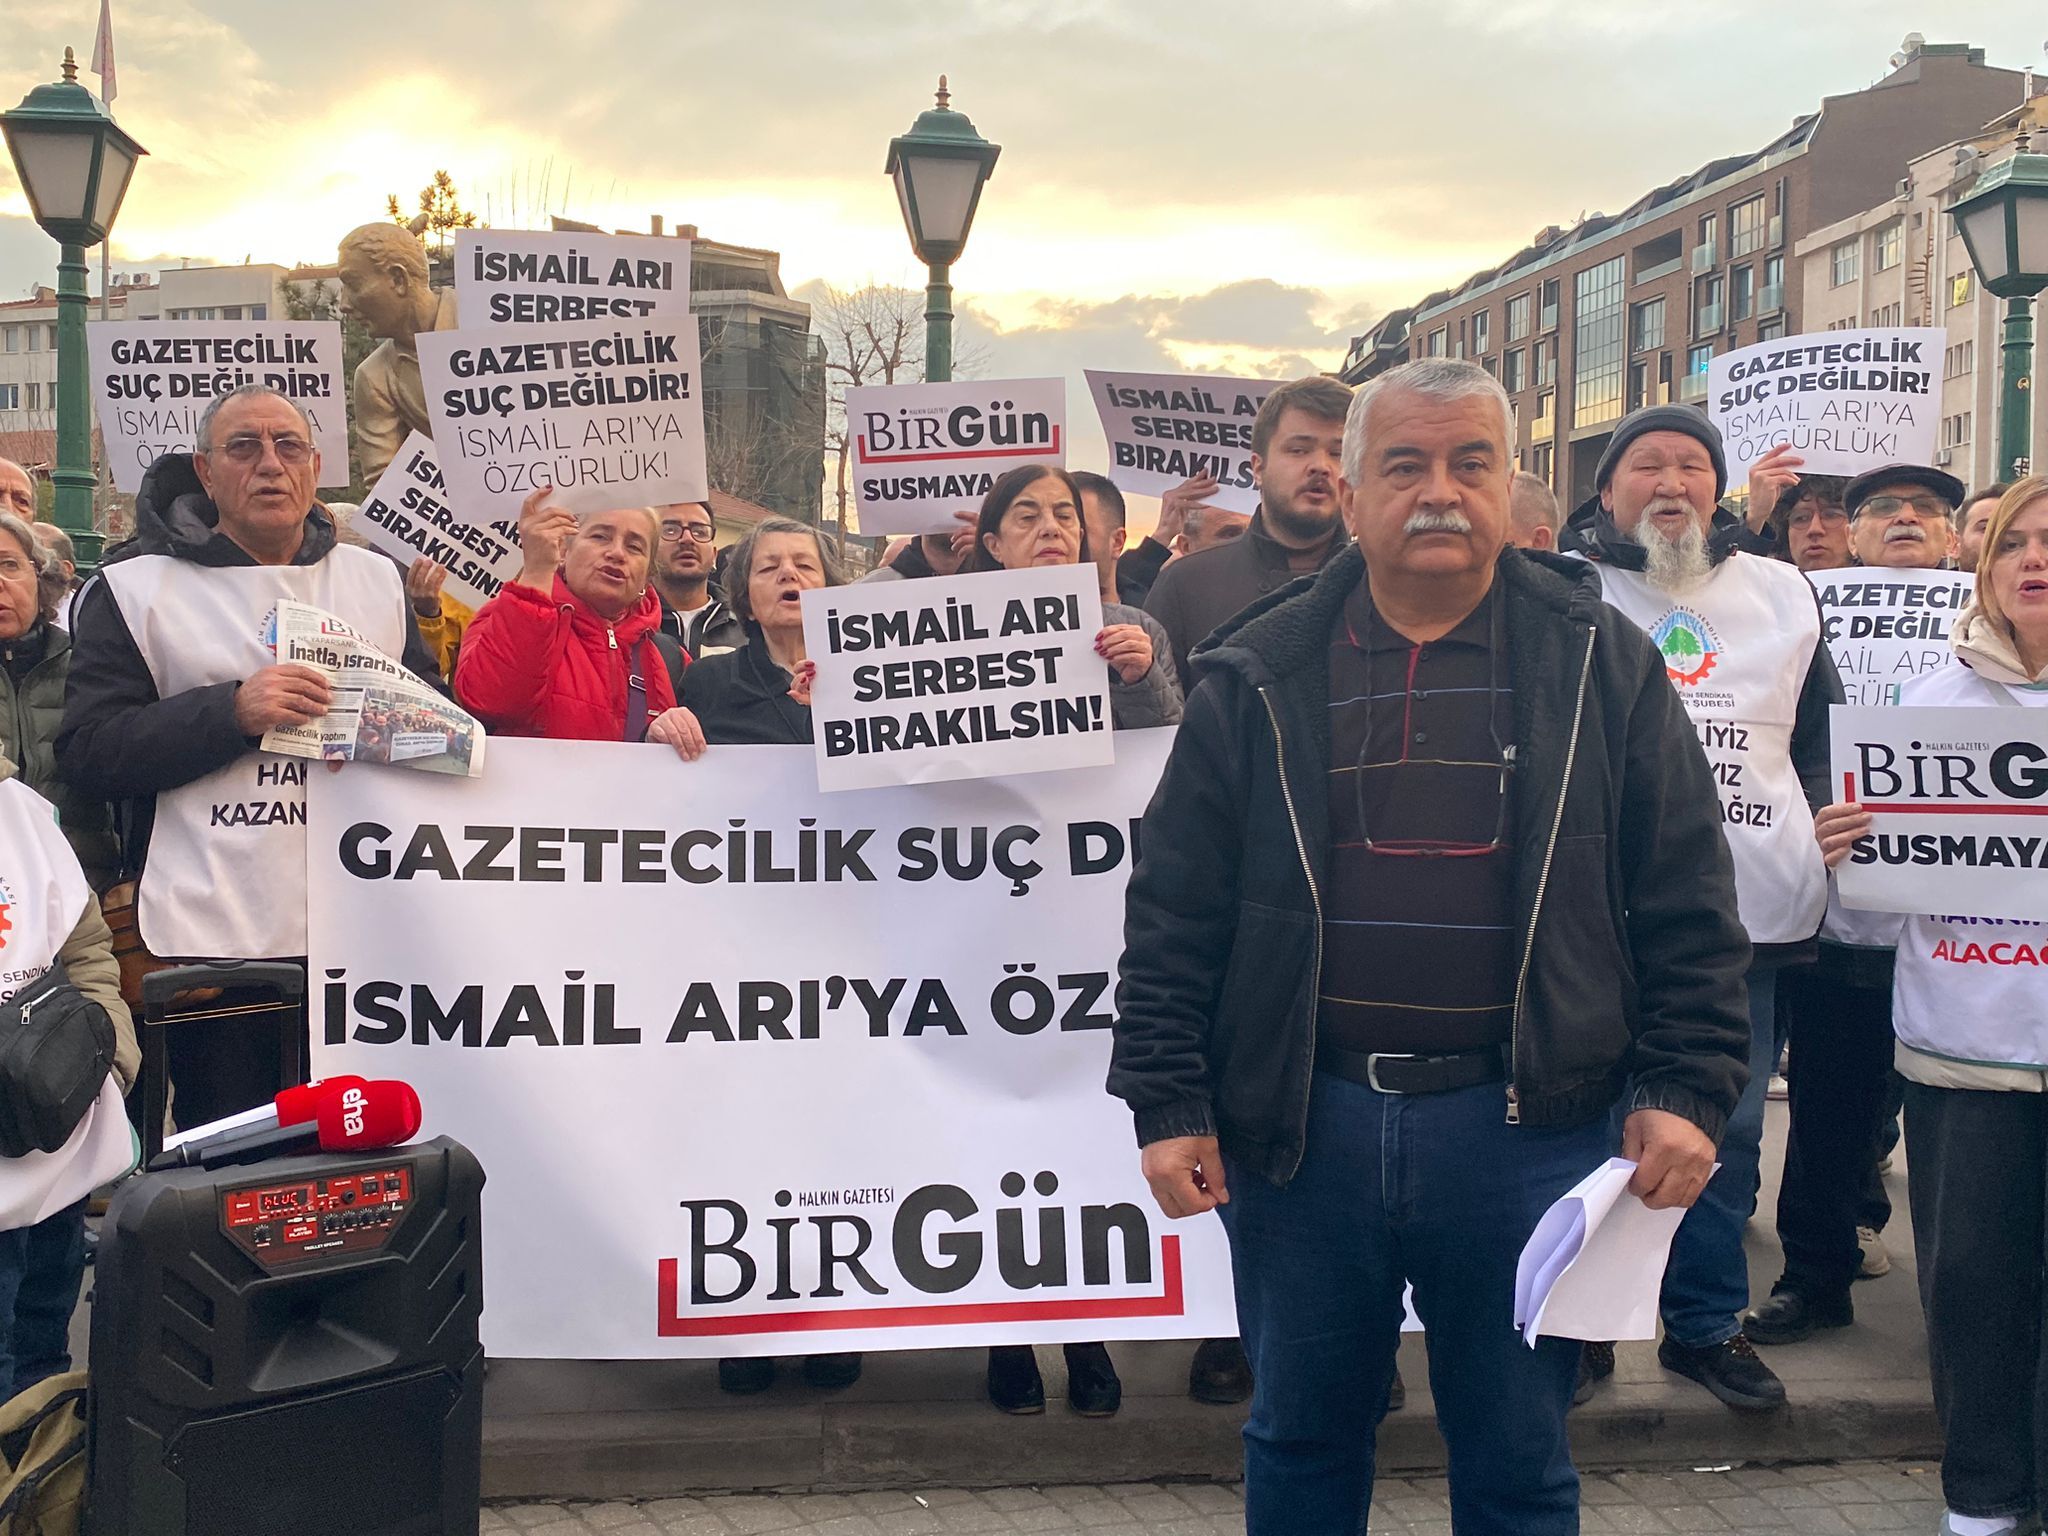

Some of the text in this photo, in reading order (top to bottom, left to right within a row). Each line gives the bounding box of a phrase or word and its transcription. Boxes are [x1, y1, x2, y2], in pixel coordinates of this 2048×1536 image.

[474, 245, 672, 290] İSMAİL ARI
[489, 293, 656, 323] SERBEST
[112, 333, 318, 364] GAZETECİLİK
[449, 330, 678, 378] GAZETECİLİK
[1728, 337, 1922, 382] GAZETECİLİK
[106, 374, 162, 402] SUÇ
[443, 368, 690, 418] SUÇ DEĞİLDİR!
[1106, 383, 1225, 415] İSMAİL
[1719, 366, 1931, 413] SUÇ DEĞİLDİR!
[457, 418, 572, 458] İSMAİL
[1725, 399, 1810, 440] İSMAİL
[1737, 425, 1897, 462] ÖZGÜRLÜK!
[483, 449, 669, 494] ÖZGÜRLÜK!
[1115, 441, 1259, 490] BIRAKILS
[400, 487, 509, 565] SERBEST
[364, 498, 504, 598] BIRAKILSIN!
[1815, 582, 1972, 609] AZETECİ
[827, 594, 1080, 654] İSMAİL ARI
[1850, 610, 1955, 640] DEĞİL
[853, 647, 1063, 702] SERBEST
[1693, 699, 1735, 708] ŞUBESİ
[320, 732, 346, 742] yaptım
[824, 694, 1104, 757] BIRAKILSIN!
[1699, 719, 1749, 751] İYİZ
[1926, 742, 1953, 751] HALKIN
[211, 801, 307, 827] KAZAN
[338, 818, 878, 884] GAZETECİLİK
[897, 824, 1044, 897] SUÇ
[1850, 834, 2048, 869] SUSMAY
[3, 965, 54, 984] SENDİK
[323, 968, 642, 1047] İSMAİL
[342, 1088, 368, 1137] eha
[799, 1186, 895, 1207] HALKIN GAZETESİ
